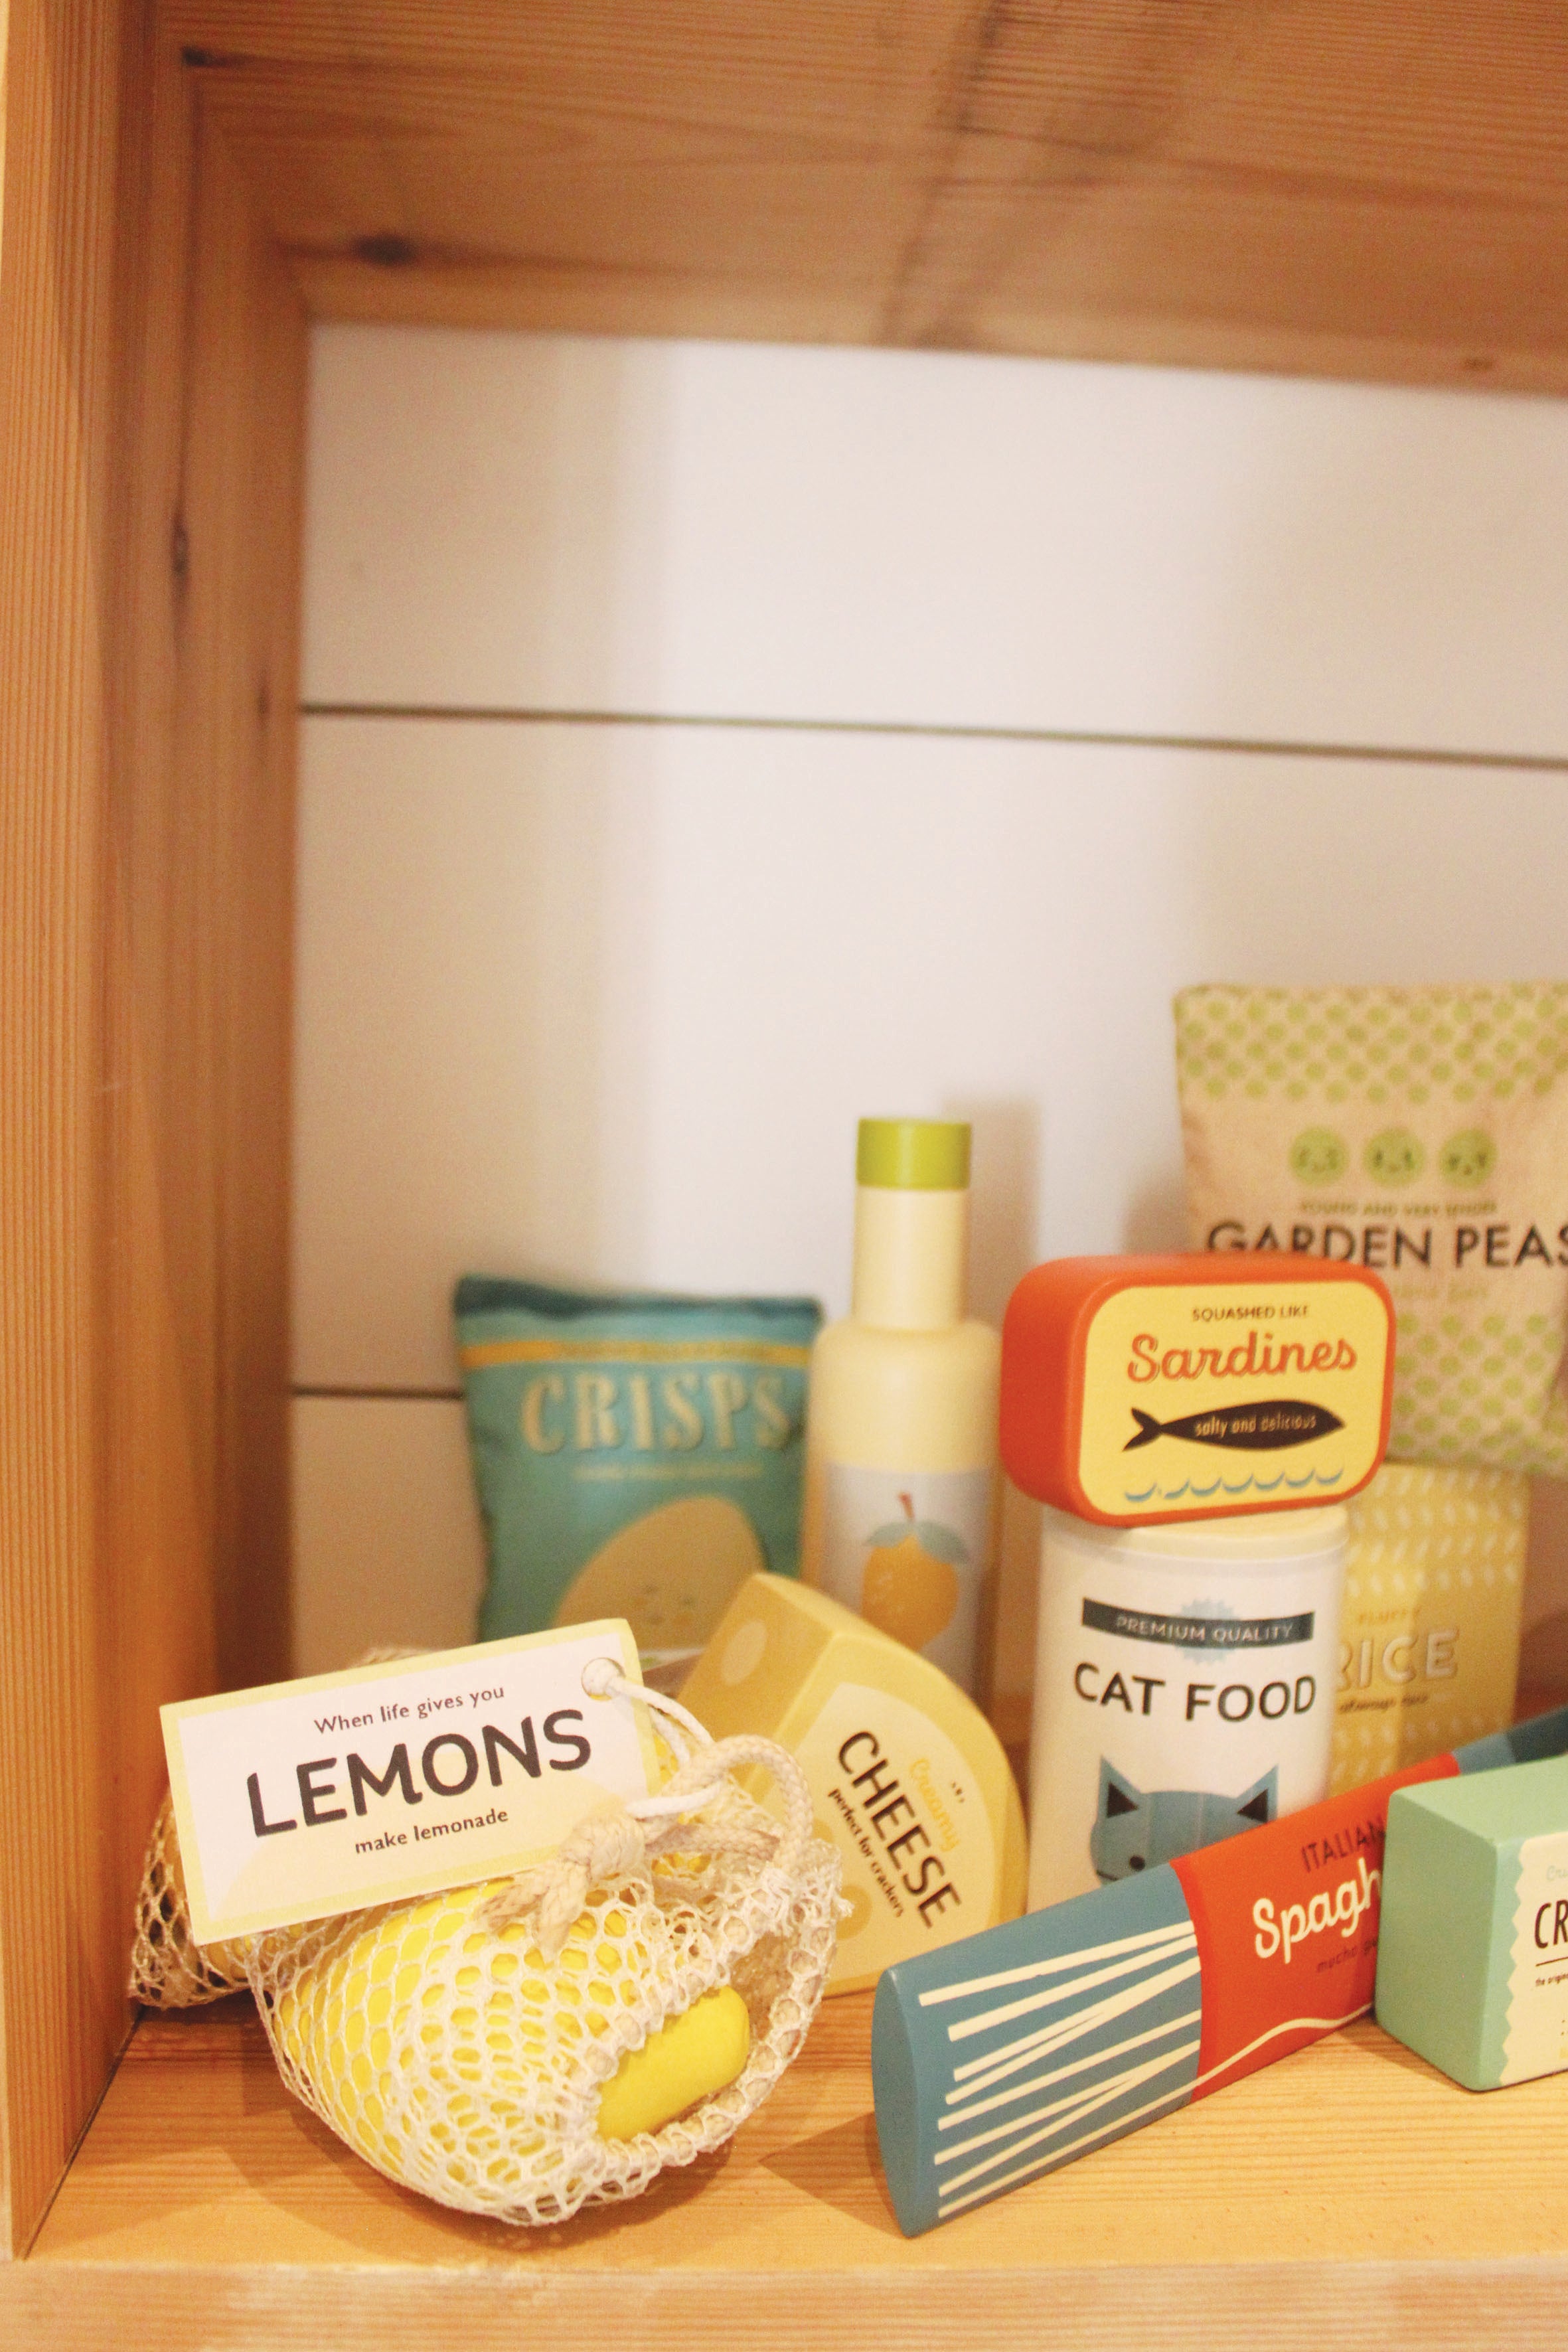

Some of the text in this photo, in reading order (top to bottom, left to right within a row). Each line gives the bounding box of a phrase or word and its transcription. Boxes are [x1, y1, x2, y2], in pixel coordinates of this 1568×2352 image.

[1208, 1219, 1432, 1267] GARDEN
[1192, 1304, 1308, 1322] SQUASHED LIKE
[1127, 1330, 1358, 1383] Sardines
[521, 1372, 793, 1454] CRISPS
[1196, 1411, 1316, 1438] salty and delicious
[1116, 1614, 1293, 1643] PREMIUM QUALITY
[315, 1687, 505, 1735] When life gives you
[1074, 1662, 1166, 1716] CAT
[1186, 1675, 1317, 1722] FOOD
[246, 1709, 592, 1838] LEMONS
[354, 1808, 509, 1855] make lemonade
[828, 1788, 904, 1919] perfect for crackers
[838, 1731, 962, 1929] CHEESE
